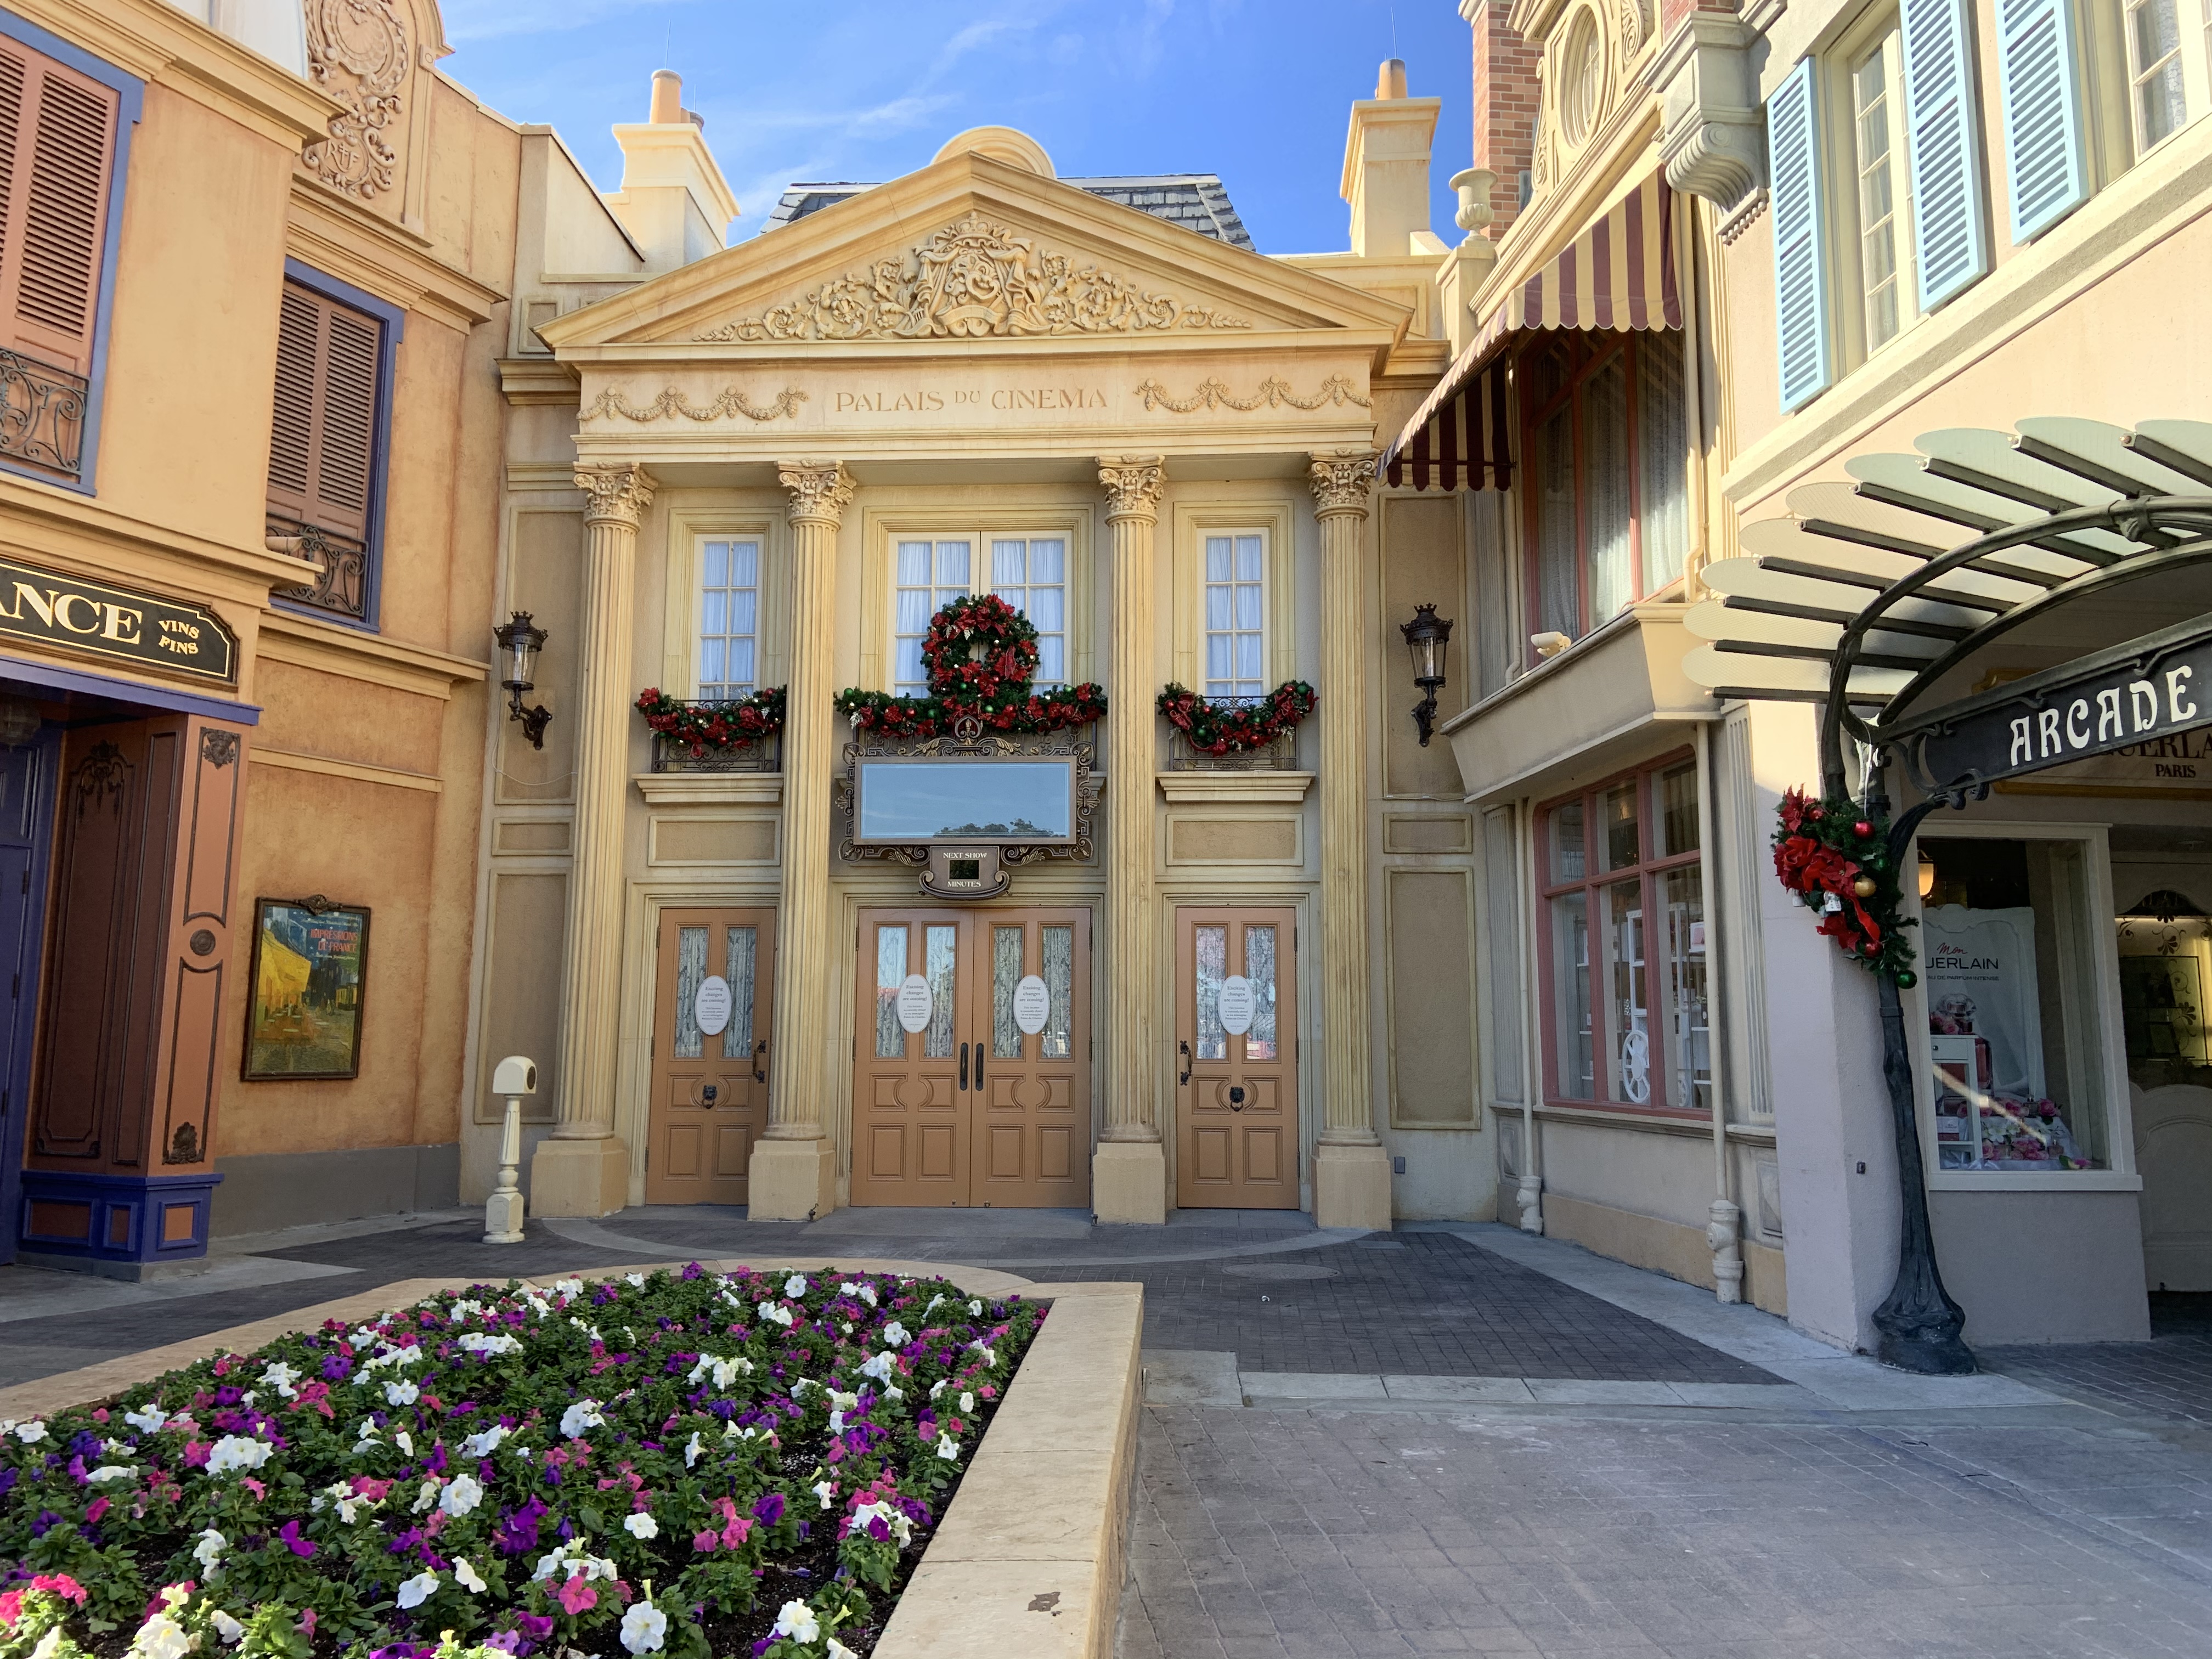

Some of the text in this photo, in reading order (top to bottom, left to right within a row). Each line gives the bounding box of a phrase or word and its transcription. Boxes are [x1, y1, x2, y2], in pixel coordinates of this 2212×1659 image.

[835, 388, 1108, 412] PALAIS DU CINEMA
[158, 619, 200, 639] VINS
[158, 635, 199, 655] FINS
[2010, 665, 2197, 766] ARCADE
[2155, 763, 2197, 778] PARIS
[1937, 942, 1968, 955] Mon
[1925, 957, 1999, 969] UERLAIN
